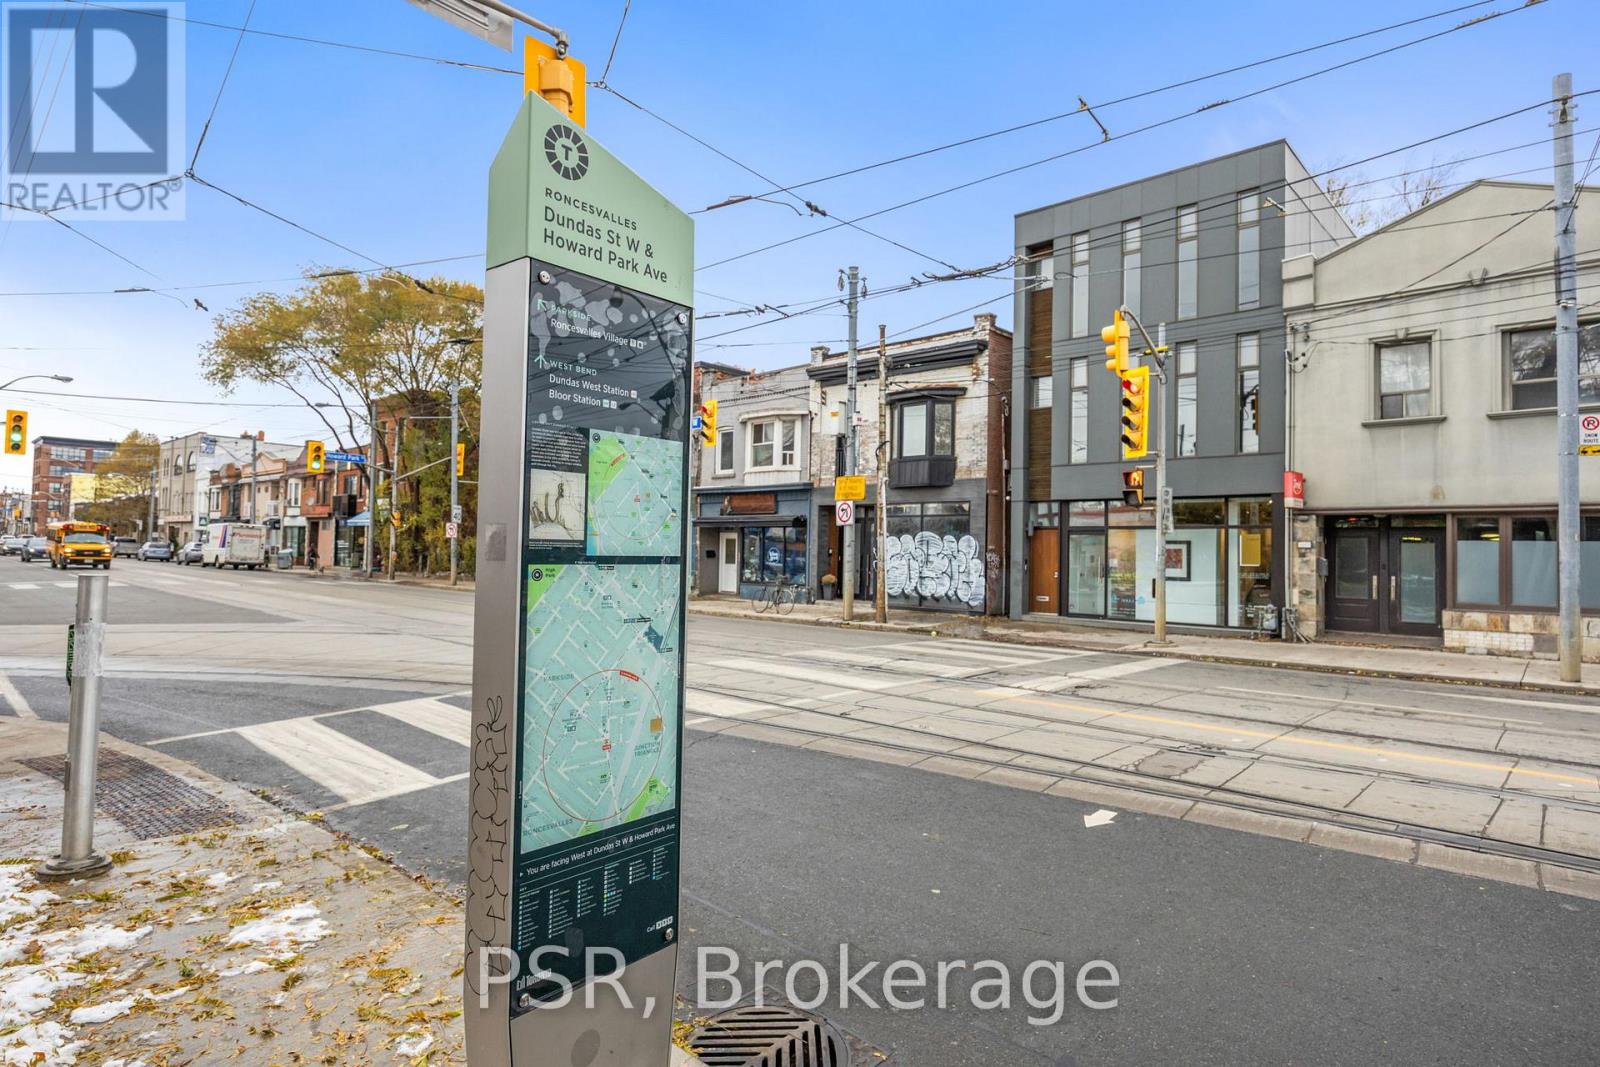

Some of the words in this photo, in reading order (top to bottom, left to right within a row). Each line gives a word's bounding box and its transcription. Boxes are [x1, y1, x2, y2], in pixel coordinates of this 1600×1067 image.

[545, 187, 637, 231] RONCESVALLES
[544, 205, 602, 240] Dundas
[606, 229, 622, 247] St
[626, 235, 640, 253] W
[644, 243, 654, 259] &
[543, 228, 603, 262] Howard
[608, 251, 639, 273] Park
[643, 263, 668, 283] Ave
[550, 318, 601, 339] Roncesvalles
[603, 332, 629, 346] Village
[549, 359, 574, 372] WEST
[575, 365, 597, 377] BEND
[549, 374, 580, 388] Dundas
[581, 379, 601, 392] West
[603, 384, 630, 397] Station
[548, 389, 571, 401] Bloor
[573, 393, 601, 407] Station
[526, 866, 539, 876] You
[540, 863, 550, 872] are
[551, 858, 570, 868] facing
[570, 851, 586, 862] West
[587, 849, 593, 857] at
[593, 843, 615, 854] Dundas
[622, 837, 629, 845] W
[628, 835, 634, 843] &
[634, 830, 654, 842] Howard
[654, 826, 665, 835] Park
[665, 823, 676, 832] Ave
